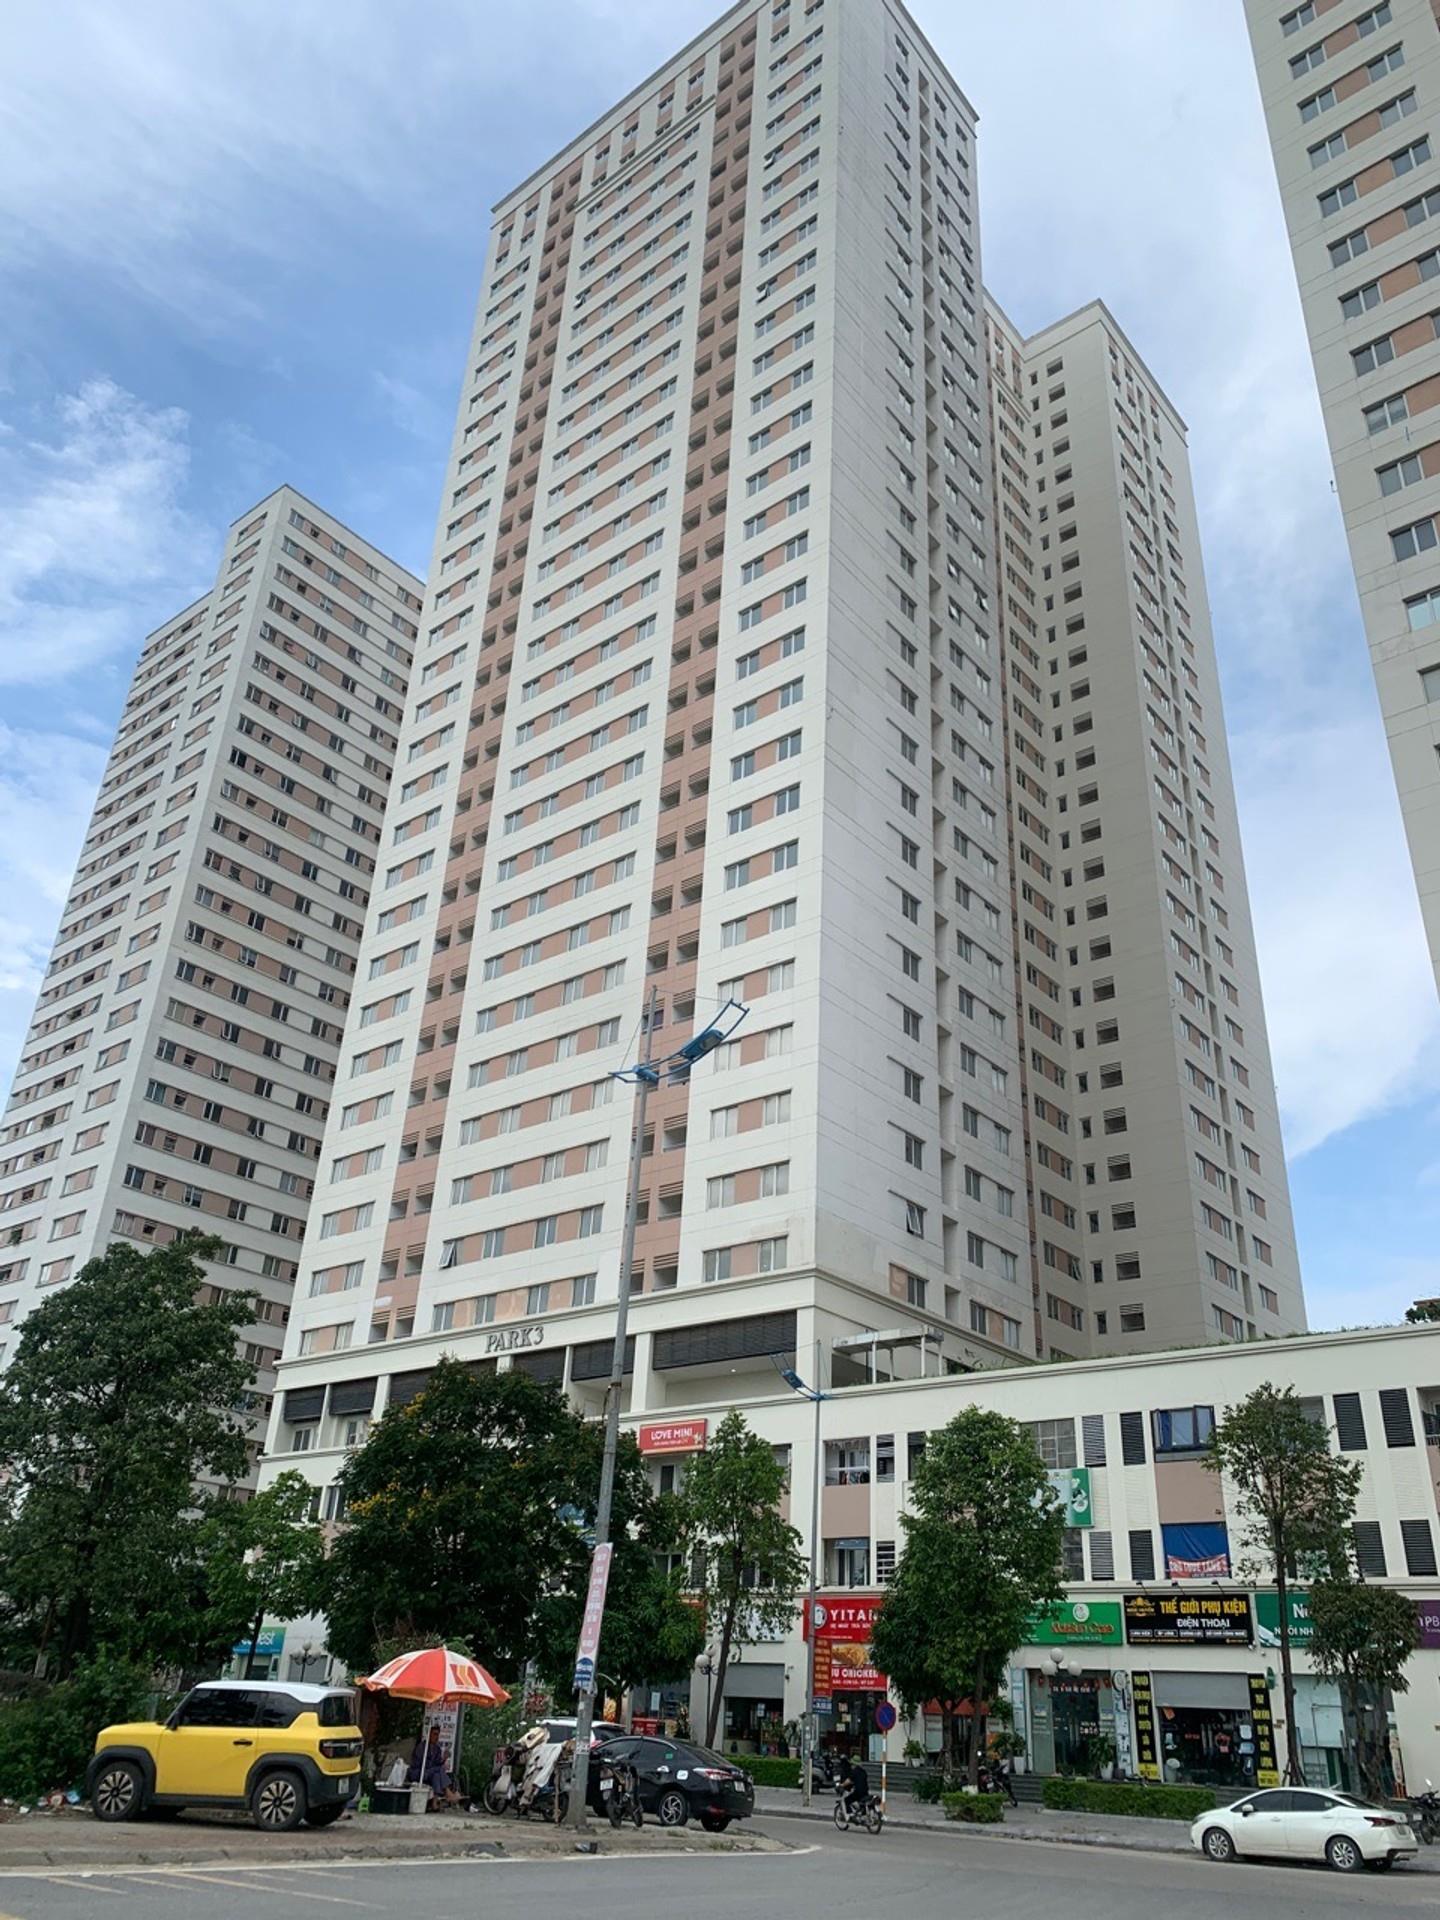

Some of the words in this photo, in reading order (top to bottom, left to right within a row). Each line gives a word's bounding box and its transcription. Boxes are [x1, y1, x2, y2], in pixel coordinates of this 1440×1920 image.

[651, 1429, 673, 1440] LOVE
[674, 1427, 693, 1438] MINI
[1160, 1597, 1178, 1614] THẾ
[1180, 1598, 1199, 1614] GIỚI
[1201, 1601, 1220, 1616] PHỤ
[1223, 1598, 1247, 1616] KIỆN
[1177, 1616, 1199, 1630] ĐIỆN
[1202, 1619, 1230, 1630] THOẠI
